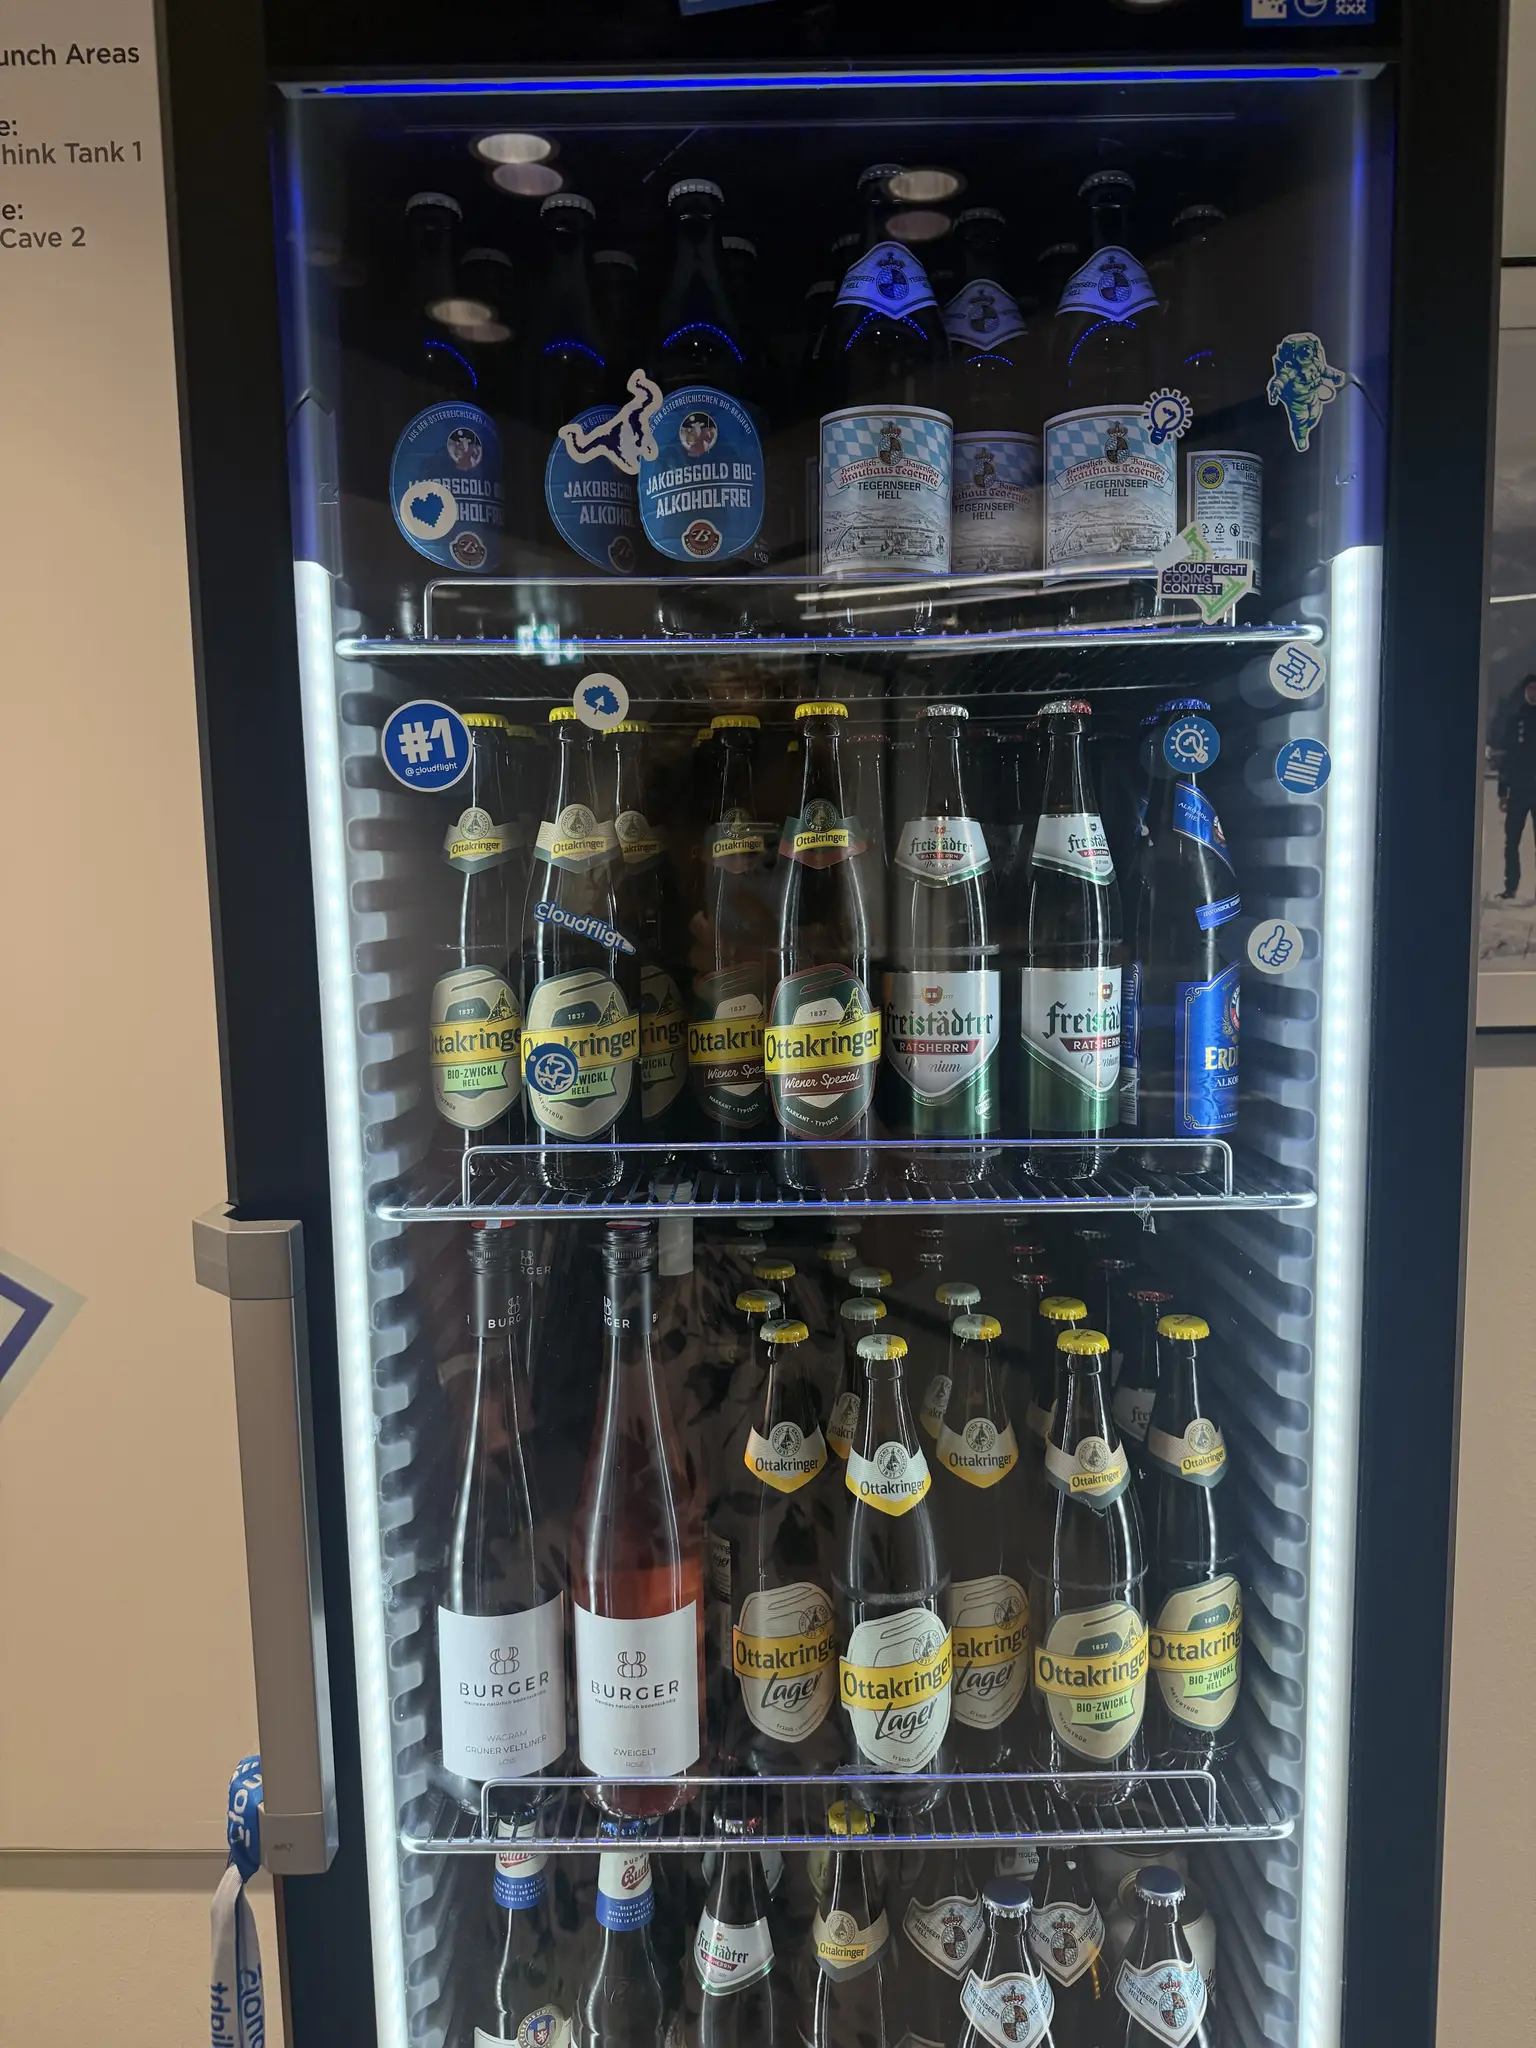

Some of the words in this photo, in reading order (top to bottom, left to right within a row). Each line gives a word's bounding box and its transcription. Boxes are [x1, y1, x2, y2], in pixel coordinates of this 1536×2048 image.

[66, 43, 140, 65] Areas
[2, 143, 56, 165] hink
[64, 142, 124, 164] Tank
[132, 141, 142, 162] 1
[2, 202, 24, 220] e:
[0, 228, 62, 249] Cave
[72, 227, 86, 247] 2
[646, 463, 729, 496] JAKOBSGOLD
[840, 466, 893, 485] Brauhaus
[895, 465, 938, 488] Tegernsee
[1065, 464, 1120, 485] Brauhaus
[1121, 463, 1165, 484] Tegernsee
[858, 481, 921, 492] TEGERNSEER
[1084, 480, 1149, 490] TEGERNSEER
[877, 491, 902, 500] HELL
[1104, 489, 1129, 498] HELL
[656, 488, 751, 519] ALKOHOLFREI
[953, 503, 1015, 514] TEGERNSEER
[972, 512, 996, 520] HELL
[1163, 573, 1212, 584] CODING
[1163, 583, 1221, 594] CONTEST
[398, 718, 456, 764] #1
[451, 840, 501, 855] Ottakringer
[552, 839, 605, 854] Ottakringer
[714, 840, 763, 853] Ottakringer
[795, 832, 847, 847] Ottakringer
[623, 843, 658, 854] akringer
[458, 1008, 475, 1016] 1837
[567, 1012, 585, 1021] 1837
[729, 1004, 747, 1013] 1837
[810, 1009, 828, 1017] 1837
[885, 1001, 994, 1037] freistädter
[766, 1026, 879, 1064] Ottakringer
[900, 1043, 969, 1053] RATSHERRN
[447, 1065, 499, 1080] BIO-ZWICKL
[707, 1065, 739, 1080] Wiener
[784, 1075, 818, 1090] Wiener
[820, 1068, 860, 1089] Spezial
[462, 1078, 481, 1088] HELL
[571, 1085, 591, 1095] HELL
[815, 1114, 839, 1127] TYPISCH
[755, 1457, 819, 1473] Ottakringer
[949, 1452, 1012, 1469] Ottakringer
[1183, 1449, 1225, 1470] Ottakringer
[860, 1477, 925, 1496] Ottakringer
[1072, 1470, 1120, 1488] Ottakringer
[1204, 1615, 1220, 1624] 1837
[735, 1632, 834, 1670] Ottakringe
[1092, 1642, 1109, 1651] 1837
[1149, 1625, 1240, 1661] Ottakring
[1039, 1643, 1148, 1687] Ottakringer
[843, 1652, 951, 1699] Ottakringer
[955, 1660, 1016, 1697] Lager
[1189, 1663, 1234, 1686] BIO-ZWICKL
[460, 1671, 549, 1698] BURGER
[591, 1679, 680, 1701] BURGER
[761, 1672, 823, 1708] Lager
[1206, 1681, 1222, 1691] HELL
[1076, 1694, 1128, 1713] BIO-ZWICKL
[875, 1698, 938, 1740] Lager
[1095, 1711, 1113, 1720] HELL
[487, 1729, 528, 1742] WAGRAM
[504, 1734, 548, 1754] VELTLINER
[613, 1748, 657, 1757] ZWEIGELT
[820, 1941, 865, 1958] Ottakringer
[1128, 1987, 1144, 2006] HELL
